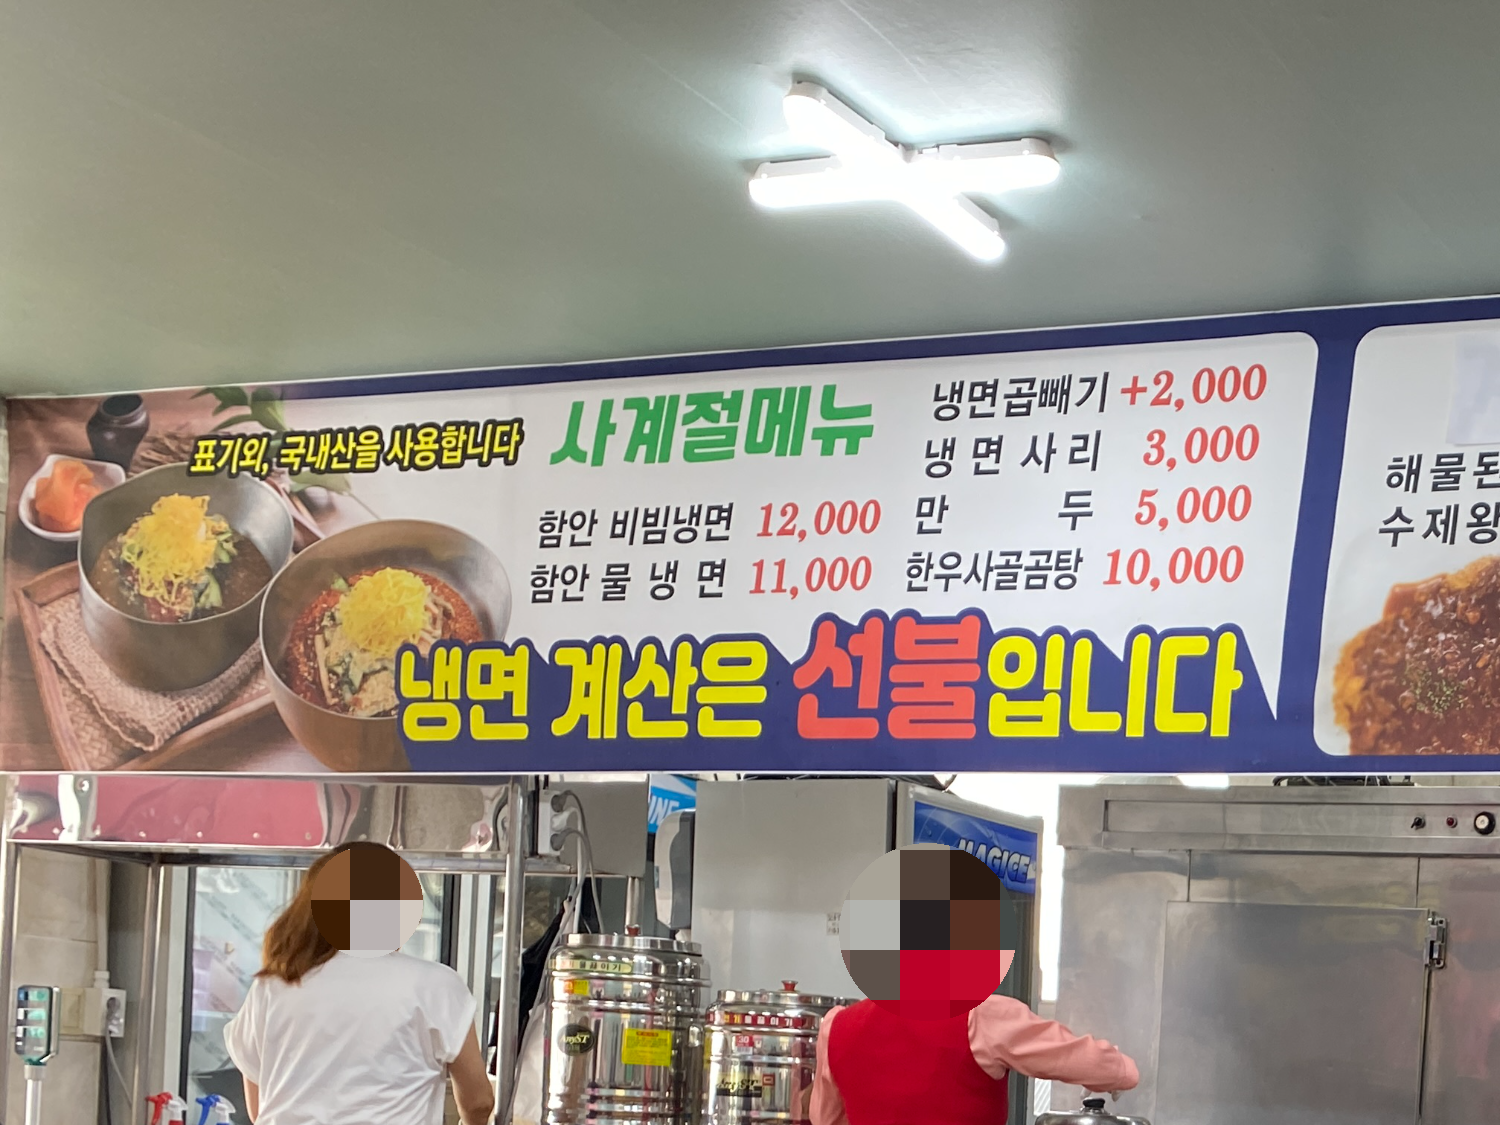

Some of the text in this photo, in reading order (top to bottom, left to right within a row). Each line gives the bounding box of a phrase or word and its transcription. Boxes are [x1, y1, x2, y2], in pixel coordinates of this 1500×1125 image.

[932, 363, 1267, 422] 냉면곱빼기 +2,000
[191, 420, 520, 477] 표기외, 국내산을 사용합니다
[550, 384, 874, 467] 사계절메뉴
[1142, 424, 1260, 473] 3,000
[538, 499, 881, 550] 함안 비빔냉면 12,000
[1134, 484, 1252, 533] 5,000
[530, 562, 590, 604] 함안
[747, 556, 873, 600] 11,000
[905, 544, 1245, 593] 한우사골곰탕 10,000
[400, 613, 1245, 742] 냉면 계산은 선불입니다
